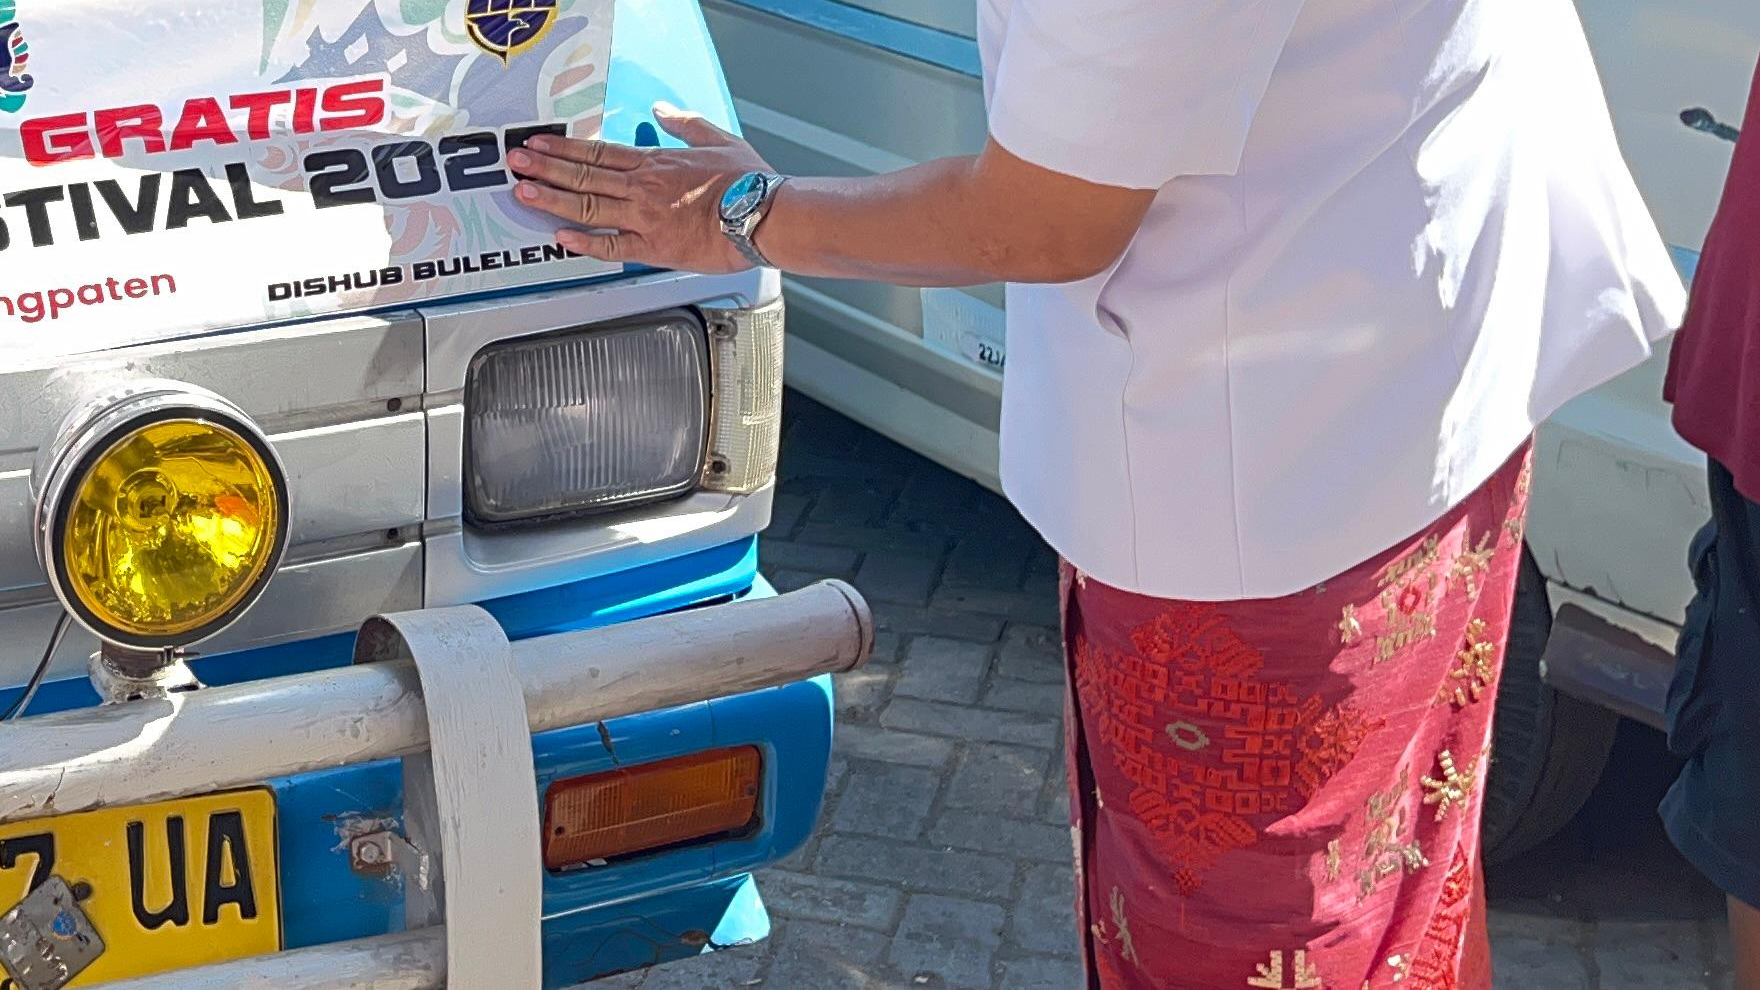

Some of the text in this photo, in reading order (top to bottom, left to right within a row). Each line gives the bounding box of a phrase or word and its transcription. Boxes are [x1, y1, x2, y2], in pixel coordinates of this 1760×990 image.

[19, 78, 387, 167] GRATIS
[268, 243, 586, 302] DISHUB BULELEN
[126, 811, 258, 932] UA
